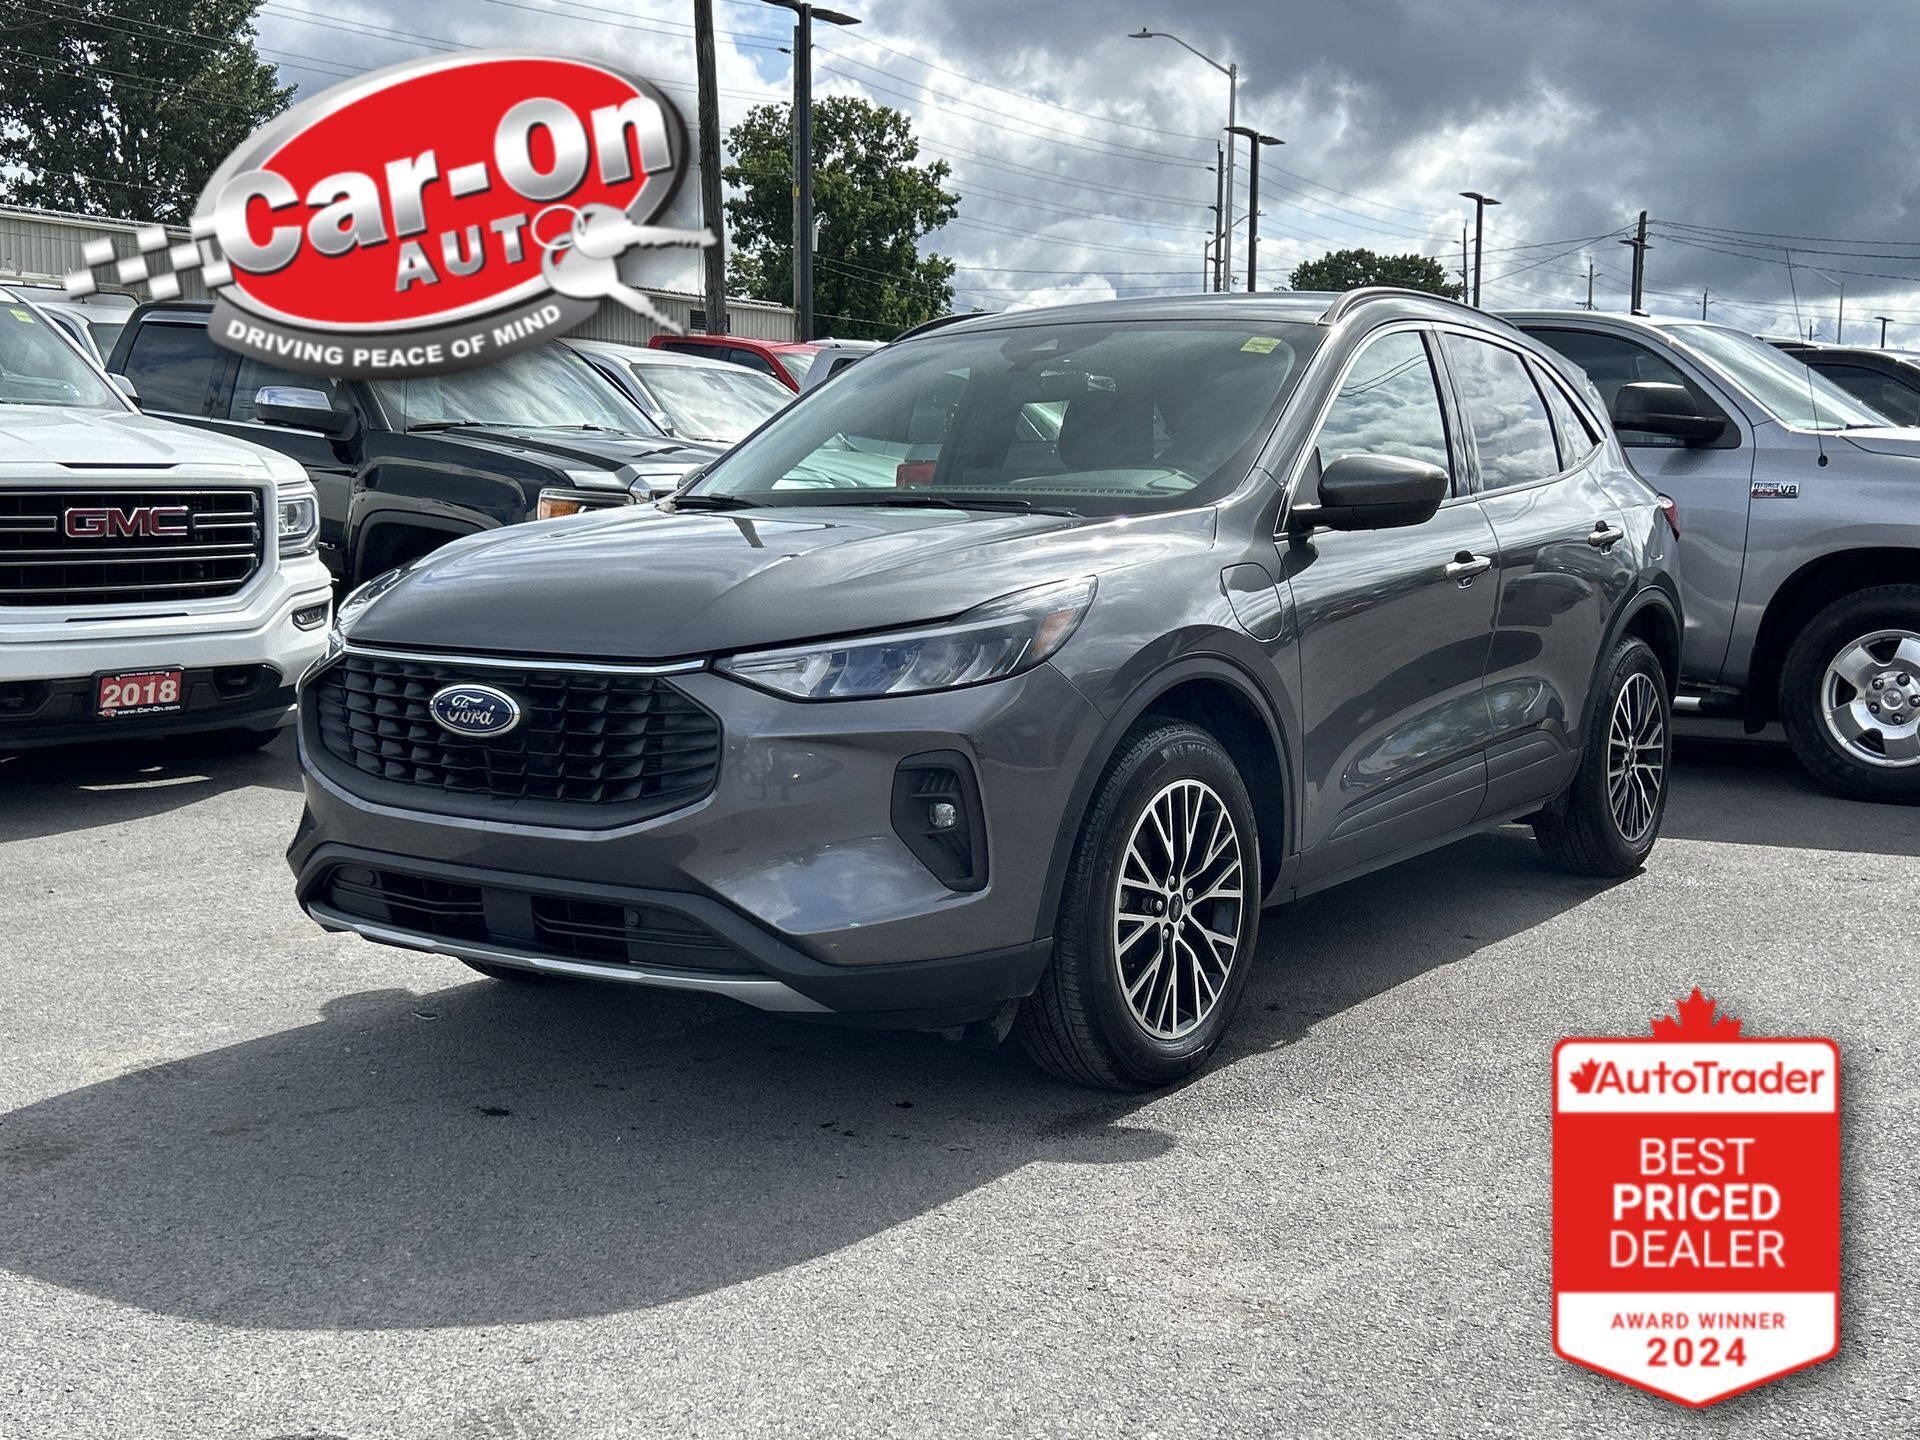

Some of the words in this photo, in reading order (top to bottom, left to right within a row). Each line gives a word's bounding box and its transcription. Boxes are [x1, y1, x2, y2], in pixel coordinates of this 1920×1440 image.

[1780, 485, 1797, 495] V8
[64, 505, 189, 538] GMC
[102, 680, 177, 708] 2018
[446, 694, 496, 725] Ford
